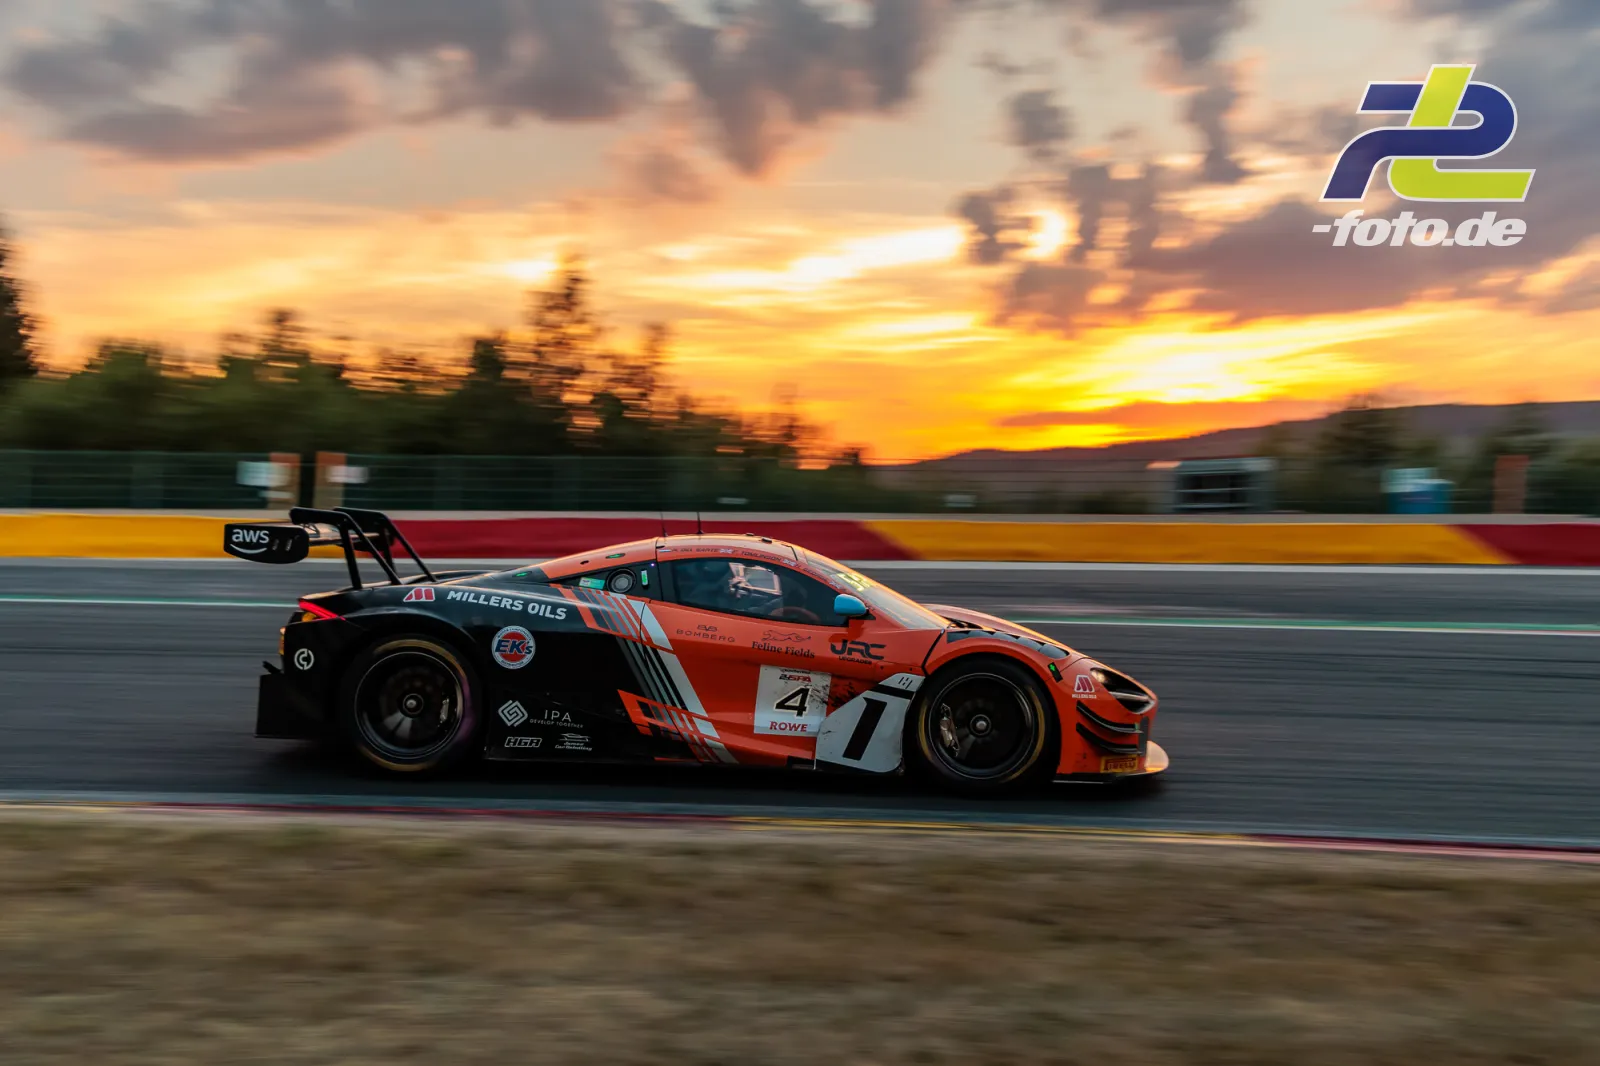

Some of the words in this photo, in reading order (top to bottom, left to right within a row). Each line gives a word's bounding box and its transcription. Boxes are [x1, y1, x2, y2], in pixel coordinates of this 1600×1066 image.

[232, 528, 270, 544] aws
[446, 590, 524, 611] MILLERS
[527, 602, 568, 620] OILS
[676, 628, 736, 643] BOMBERG
[751, 640, 782, 655] Feline
[785, 646, 816, 660] Fields
[830, 638, 887, 661] JRC
[774, 686, 812, 719] 4
[544, 709, 572, 722] IPA
[769, 720, 808, 732] ROWE
